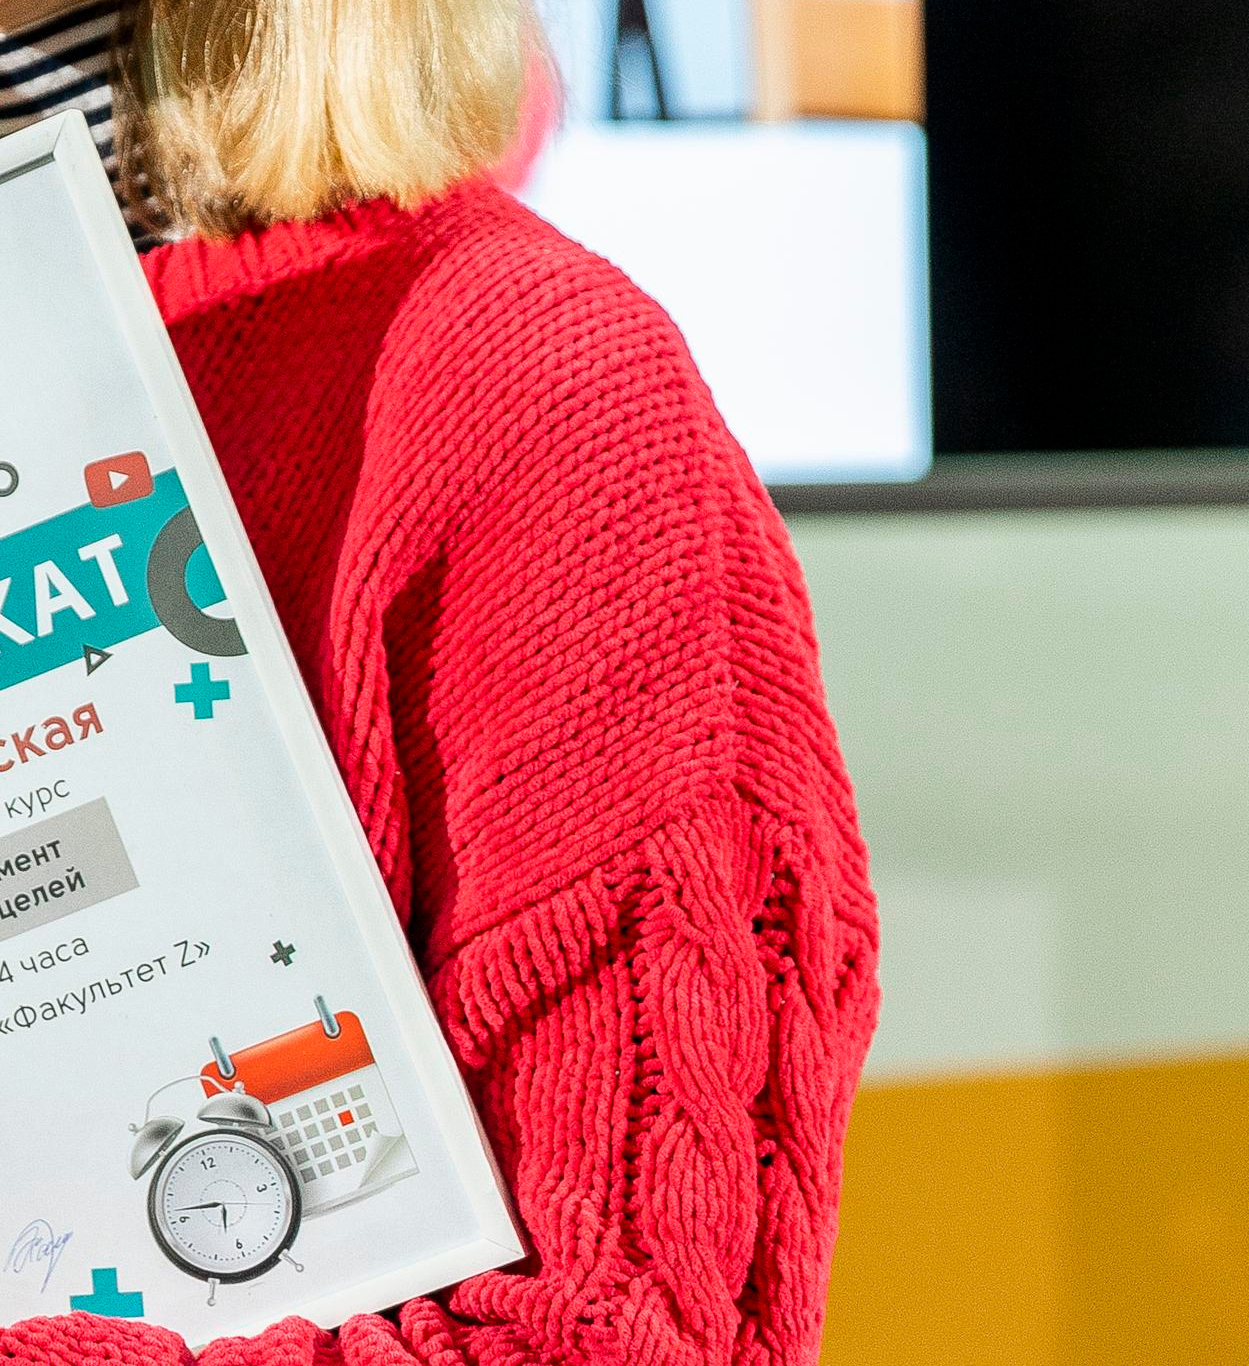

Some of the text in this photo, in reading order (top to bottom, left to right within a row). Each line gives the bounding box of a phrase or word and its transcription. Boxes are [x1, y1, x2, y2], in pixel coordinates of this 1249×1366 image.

[4, 777, 70, 819] курс
[19, 937, 90, 974] часа
[173, 940, 211, 969] Z»
[200, 1157, 216, 1170] 12
